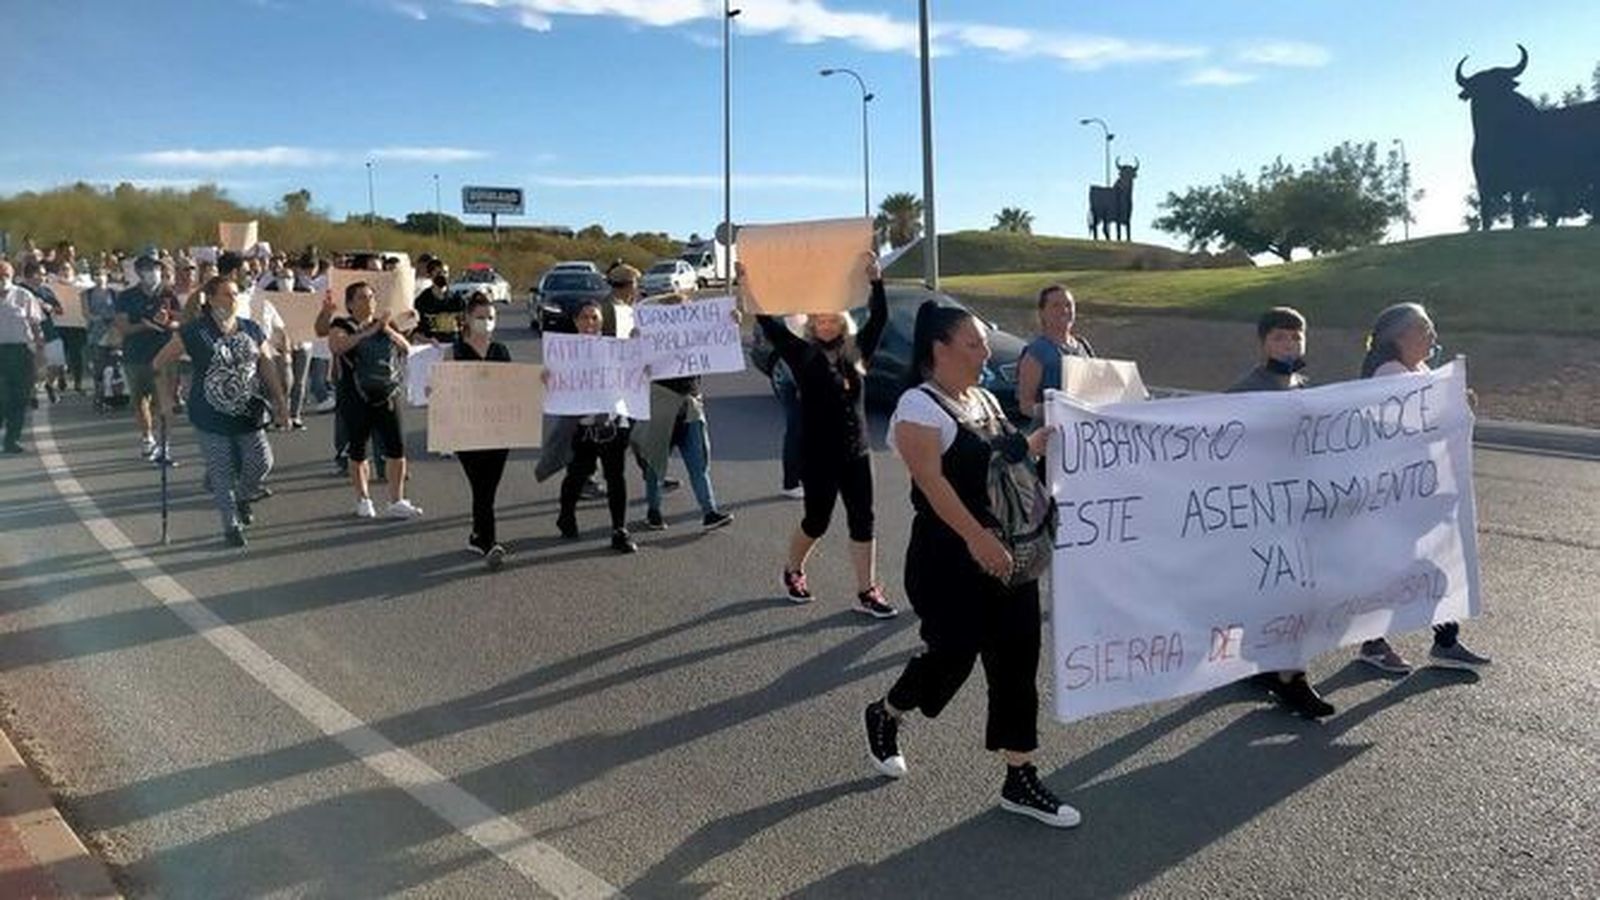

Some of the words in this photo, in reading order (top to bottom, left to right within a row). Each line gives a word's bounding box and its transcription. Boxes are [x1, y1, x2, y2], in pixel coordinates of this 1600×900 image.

[1061, 420, 1246, 475] URBANISMO
[1292, 385, 1439, 457] RECONOCE
[1054, 496, 1143, 549] ESTE
[1181, 459, 1440, 538] ASENTAMIENTO
[1251, 544, 1318, 591] YA!!
[1208, 622, 1244, 662] DE
